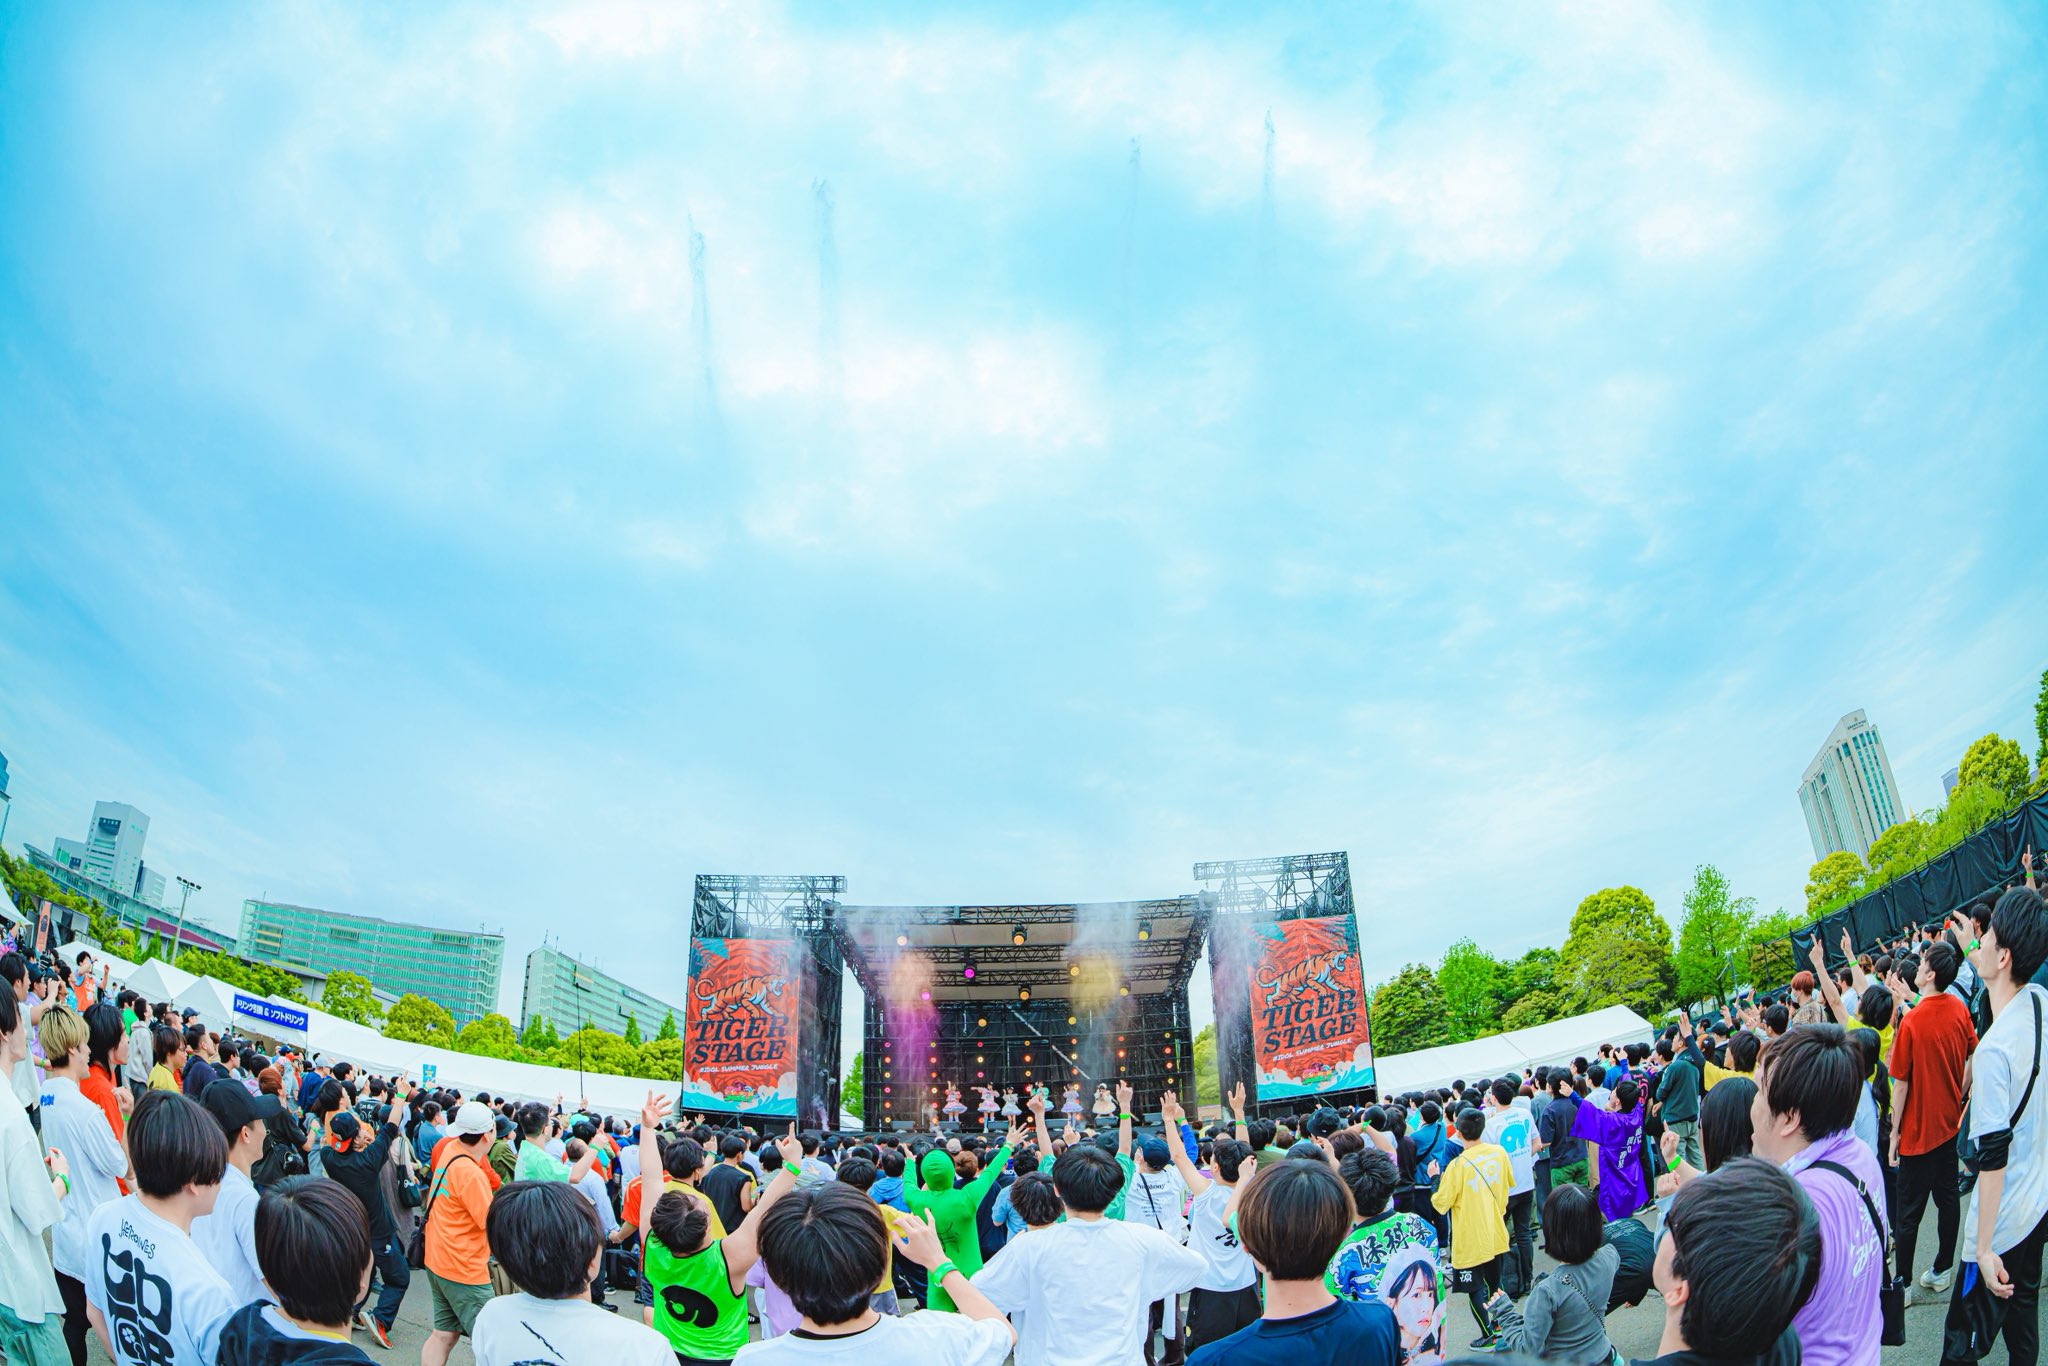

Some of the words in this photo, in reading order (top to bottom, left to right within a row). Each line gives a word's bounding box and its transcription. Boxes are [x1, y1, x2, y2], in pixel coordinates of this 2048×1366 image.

[270, 1009, 305, 1026] ソフトドリンク
[1262, 989, 1356, 1031] TIGER
[695, 1015, 789, 1041] TIGER
[1263, 1013, 1357, 1054] STAGE
[691, 1039, 787, 1064] STAGE
[1296, 1044, 1325, 1056] SUMMER
[1326, 1037, 1352, 1048] JUNGLE
[721, 1064, 749, 1072] SUMMER
[751, 1063, 778, 1071] JUNGLE
[118, 1217, 156, 1260] HEROINES
